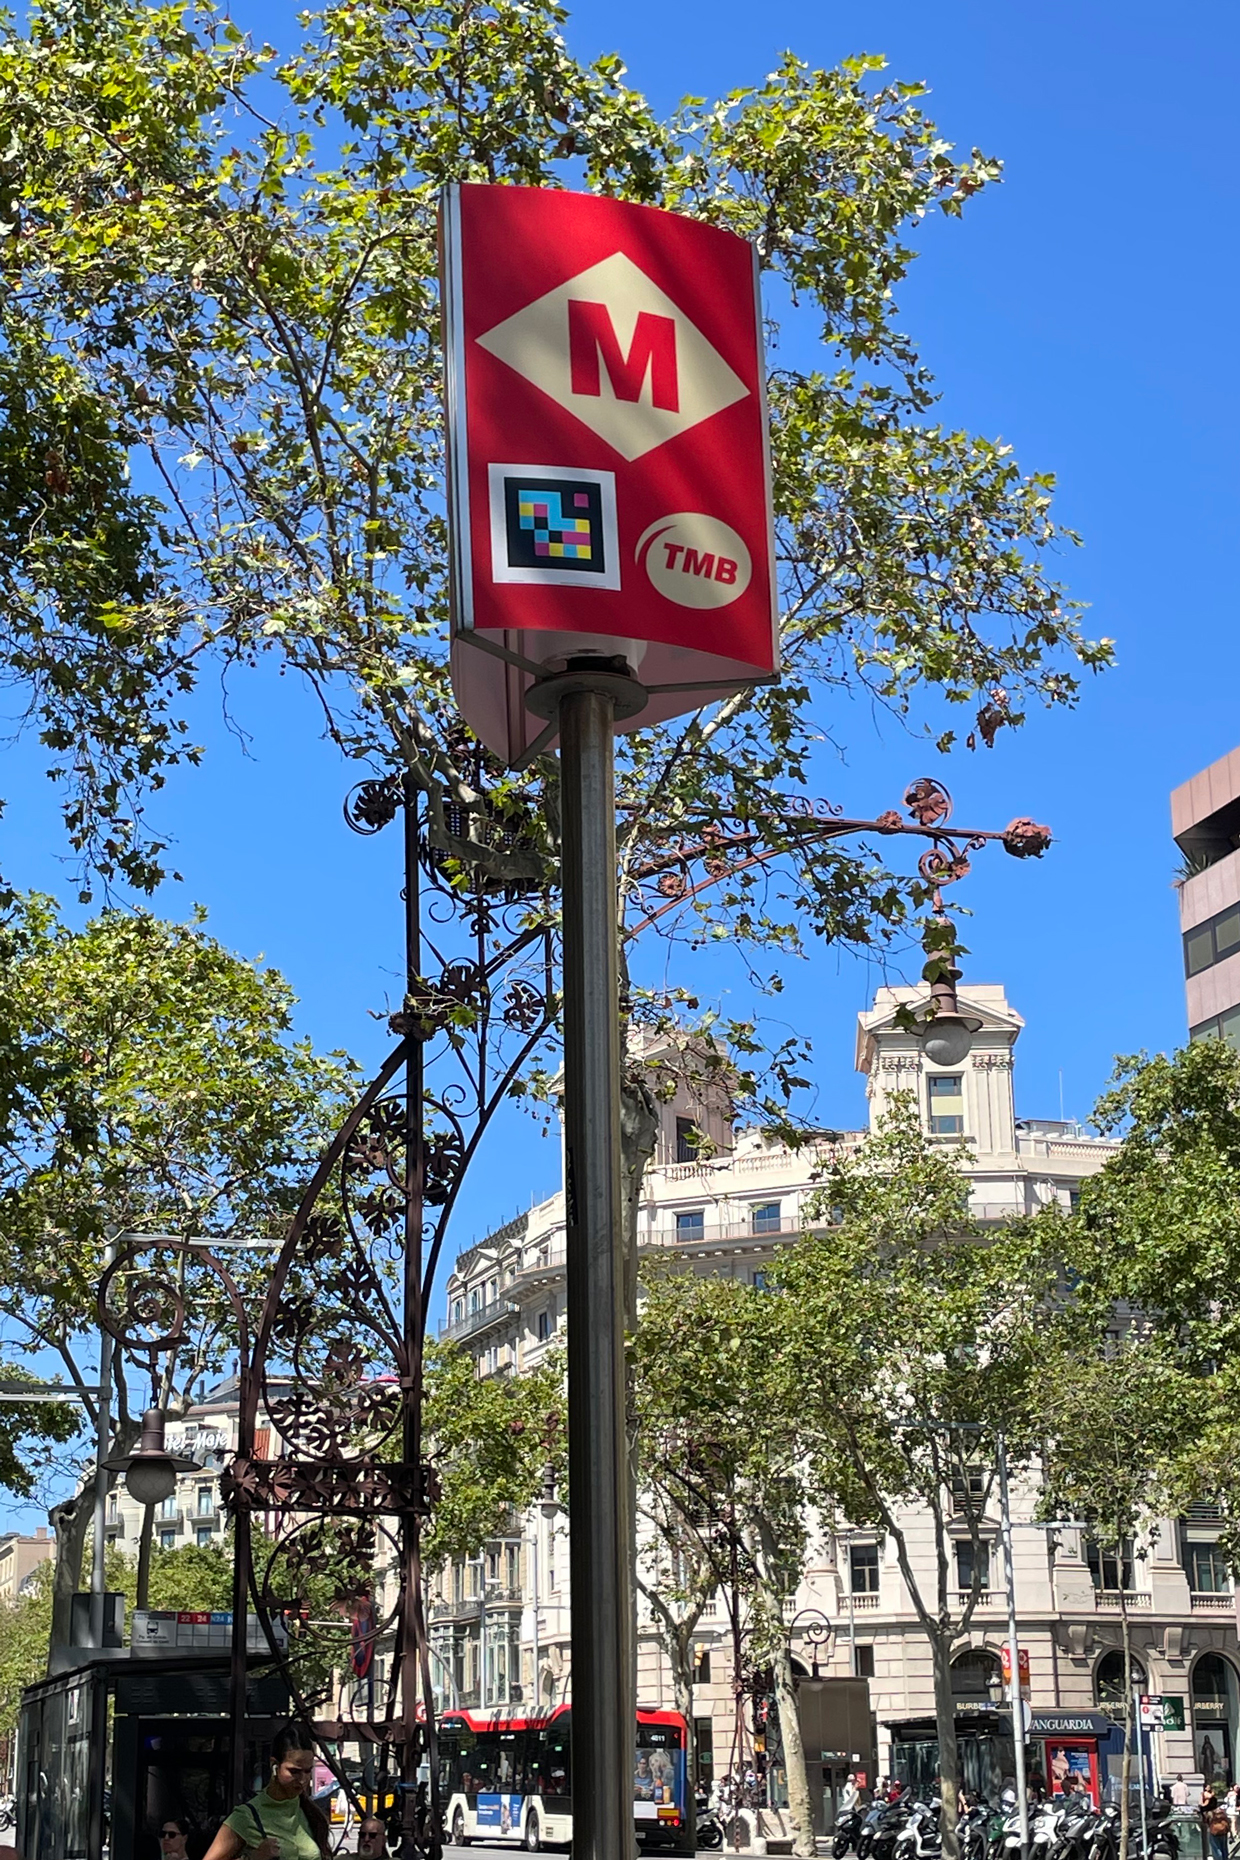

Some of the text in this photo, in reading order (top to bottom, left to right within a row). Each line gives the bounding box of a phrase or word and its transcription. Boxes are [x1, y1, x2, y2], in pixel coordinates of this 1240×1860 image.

[567, 298, 680, 414] M
[662, 541, 738, 586] TMB
[191, 1430, 228, 1451] Maje
[180, 1615, 191, 1623] 22
[197, 1615, 207, 1623] 24
